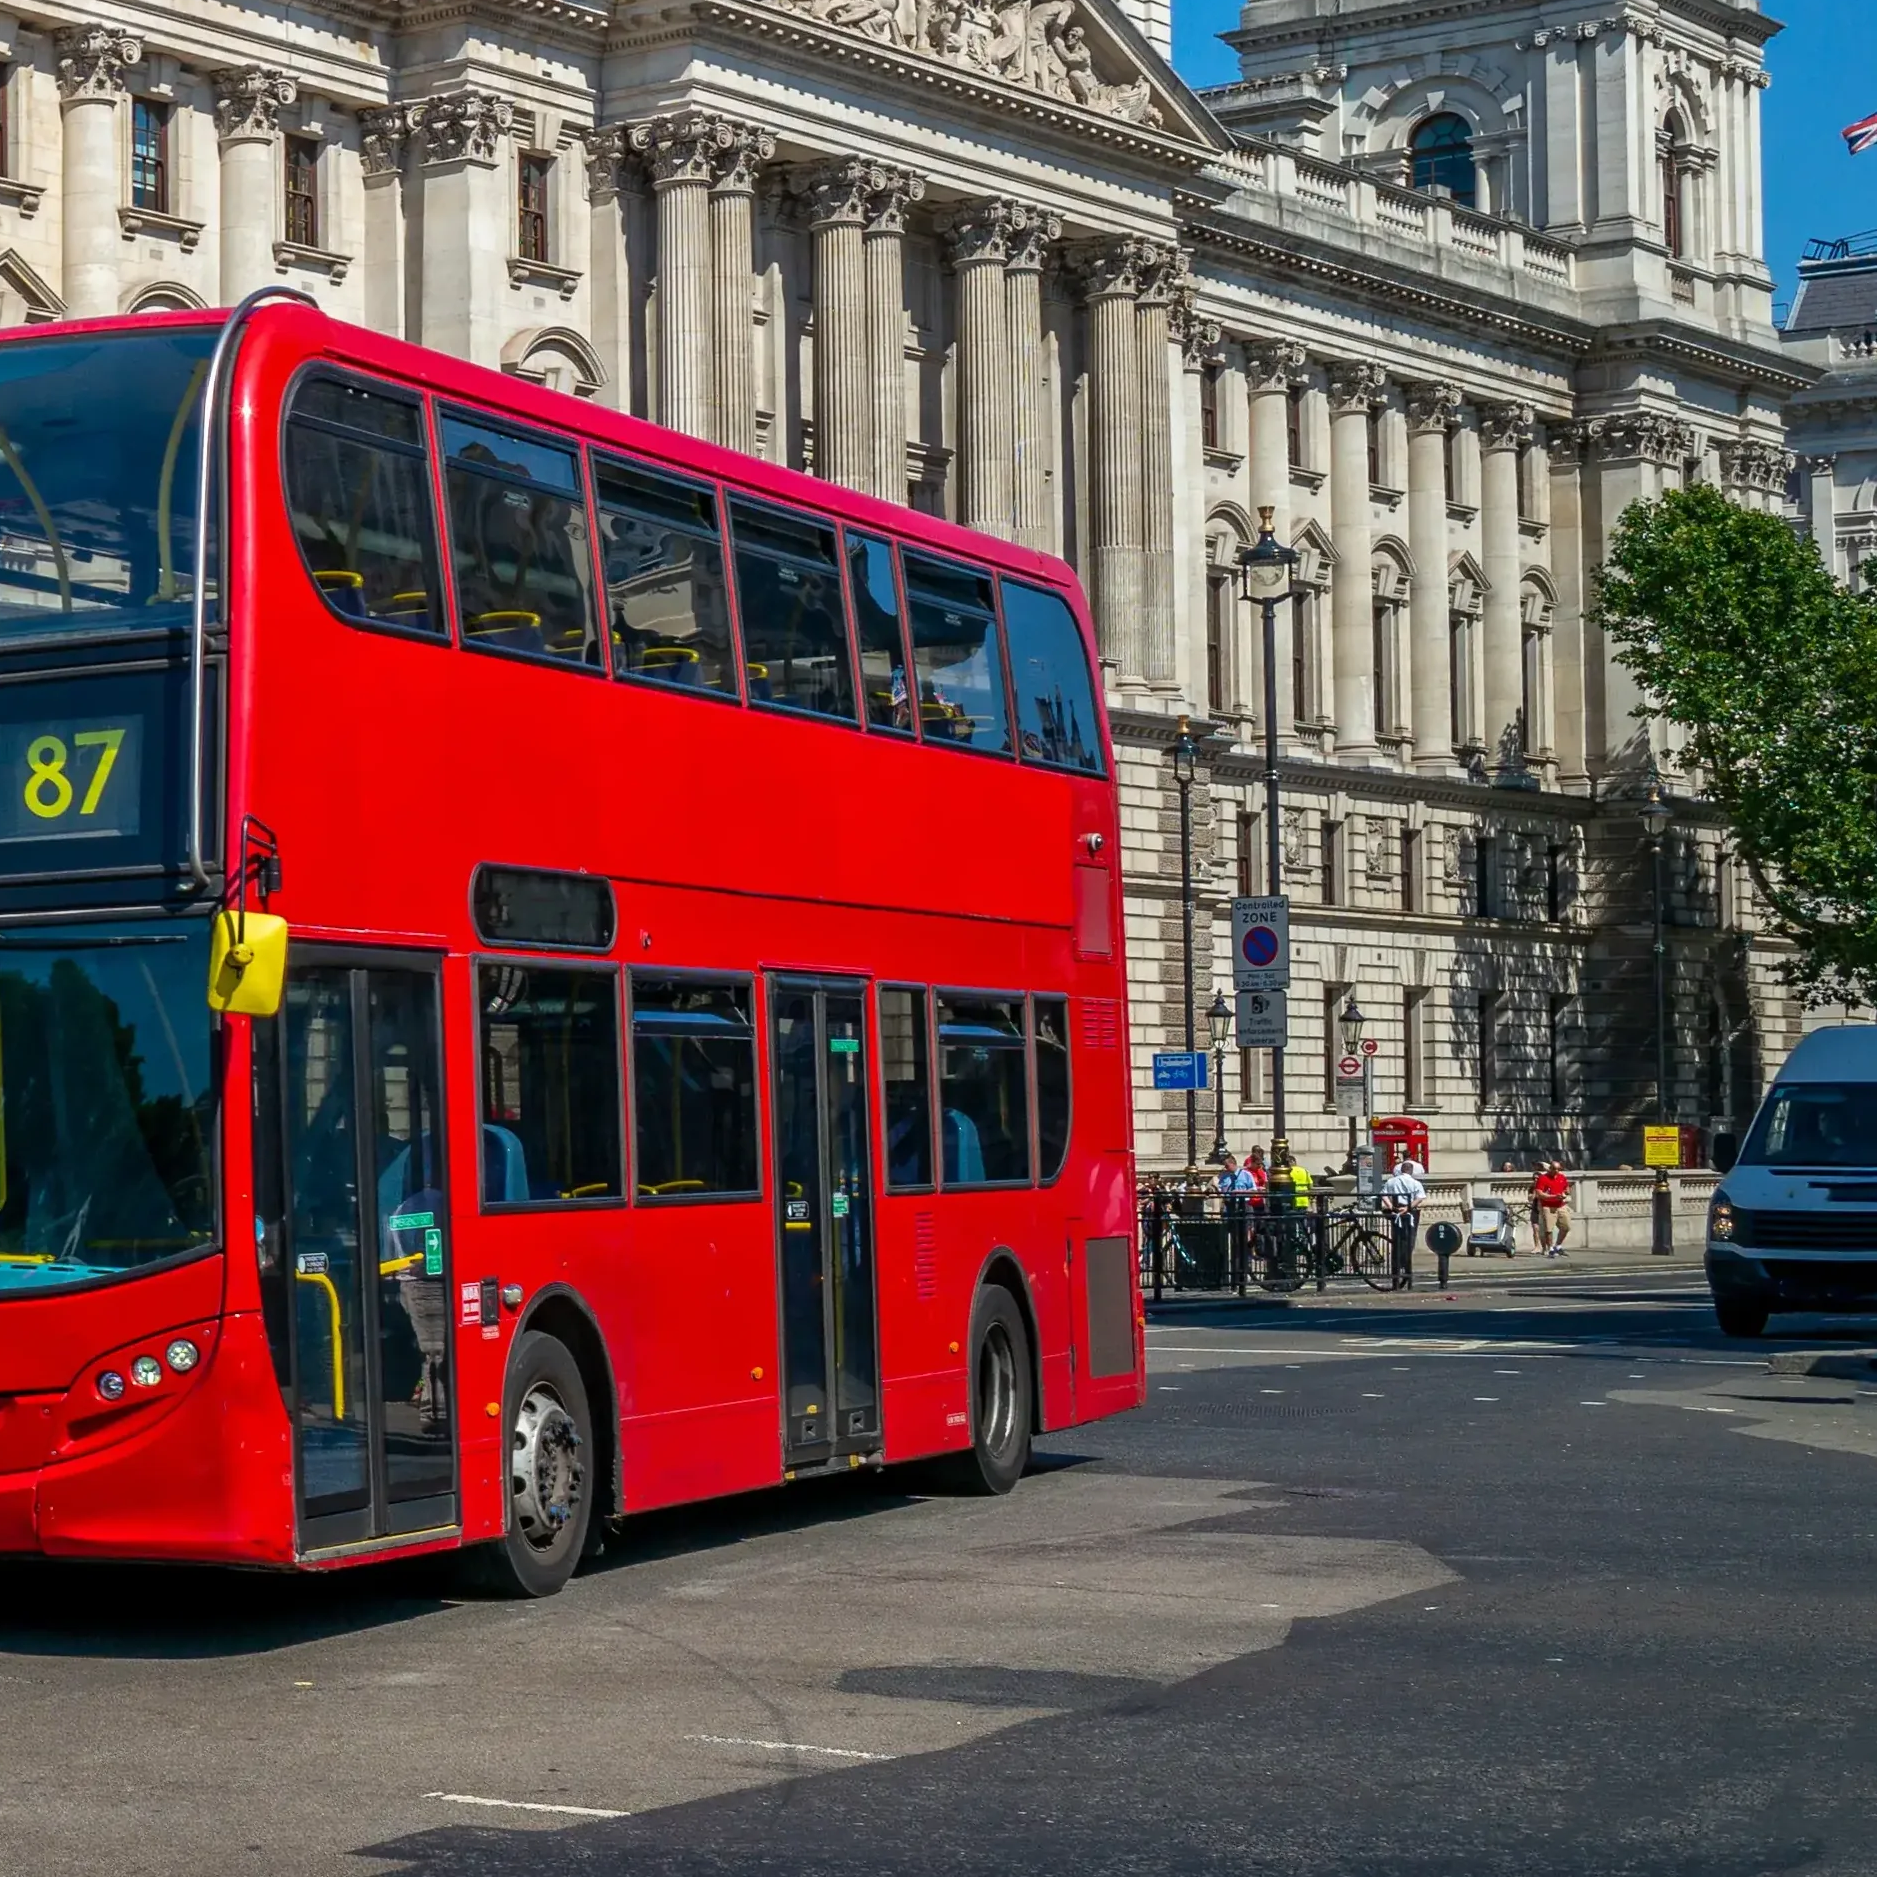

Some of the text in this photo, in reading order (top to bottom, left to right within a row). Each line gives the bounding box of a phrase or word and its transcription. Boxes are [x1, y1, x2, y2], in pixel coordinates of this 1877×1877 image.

[24, 729, 126, 818] 87
[1235, 899, 1284, 910] Controlled
[1242, 912, 1277, 923] ZONE
